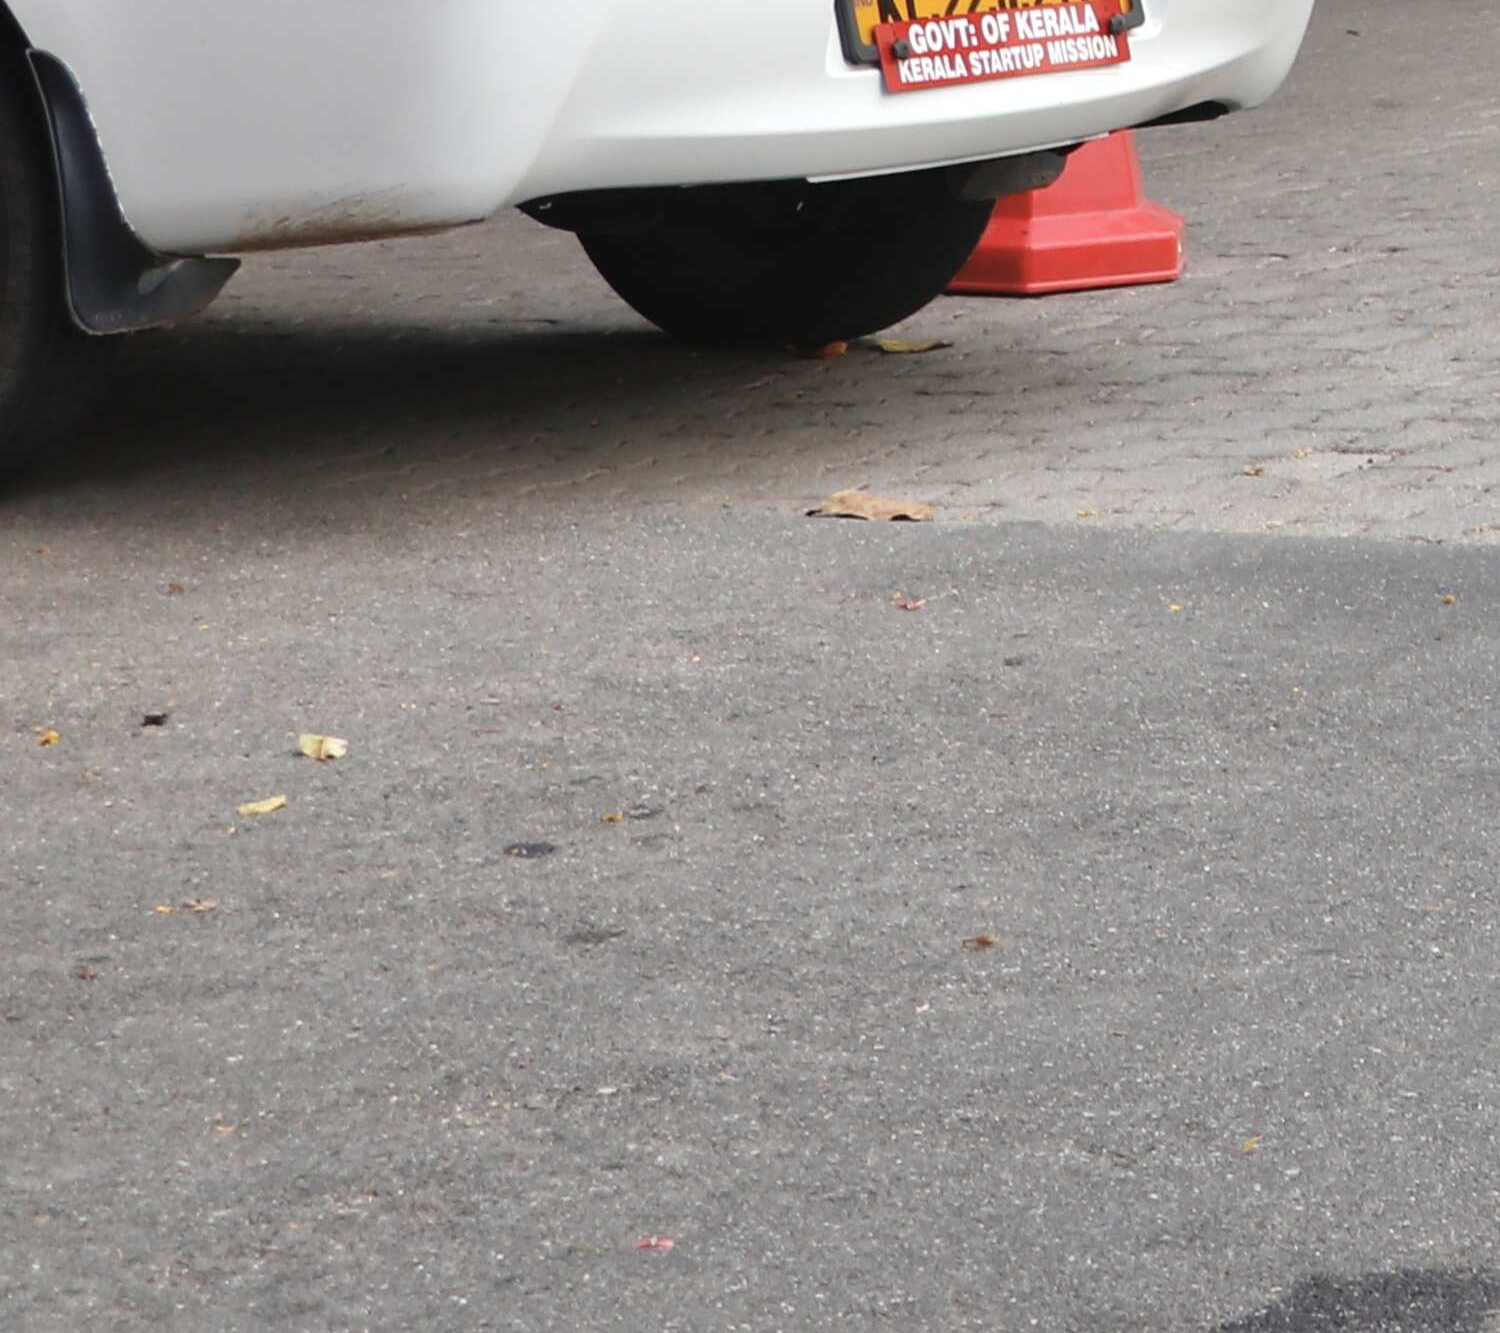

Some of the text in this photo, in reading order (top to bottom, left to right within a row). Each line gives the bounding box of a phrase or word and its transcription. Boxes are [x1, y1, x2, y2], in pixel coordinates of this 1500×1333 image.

[907, 4, 1100, 55] GOVT: OF KERALA
[900, 35, 1118, 83] KERALA STARTUP MISSION
